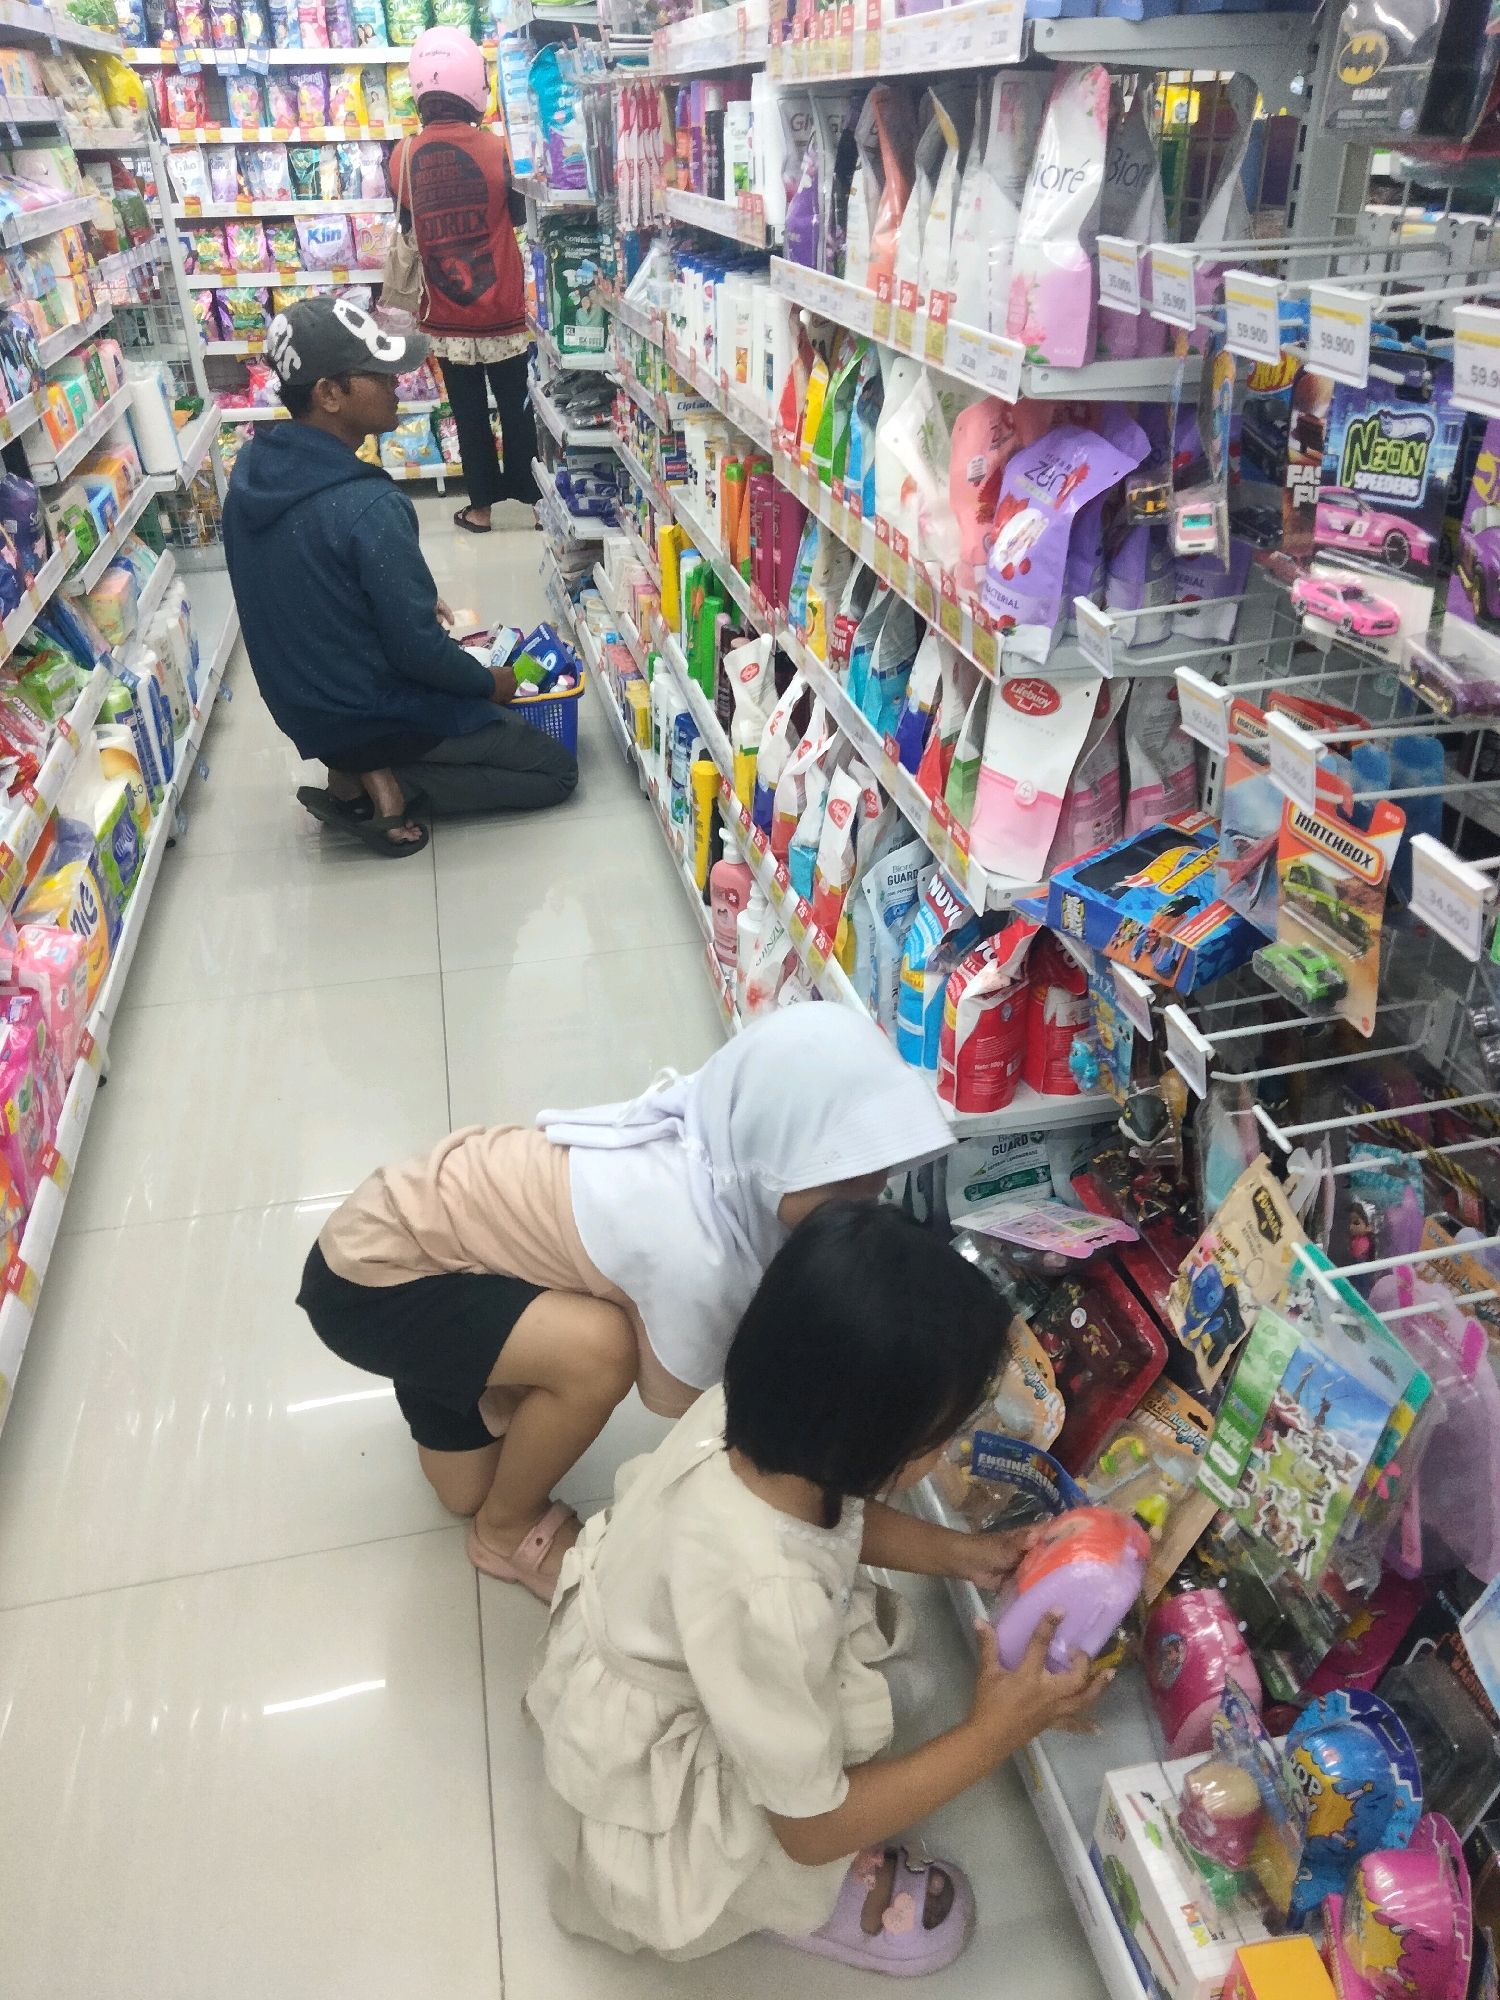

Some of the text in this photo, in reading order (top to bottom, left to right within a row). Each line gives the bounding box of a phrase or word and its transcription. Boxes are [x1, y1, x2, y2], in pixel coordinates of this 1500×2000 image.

[307, 227, 343, 245] Klin
[359, 228, 392, 252] Dai
[1236, 321, 1268, 345] 59.900
[1320, 331, 1356, 357] 59.900
[1340, 419, 1428, 488] NEON
[1353, 471, 1421, 497] SPEEDERS
[1011, 682, 1052, 709] Lifebuoy
[1293, 811, 1374, 870] MATCHBOX
[886, 868, 919, 886] GUARD
[991, 1133, 1029, 1157] GUARD
